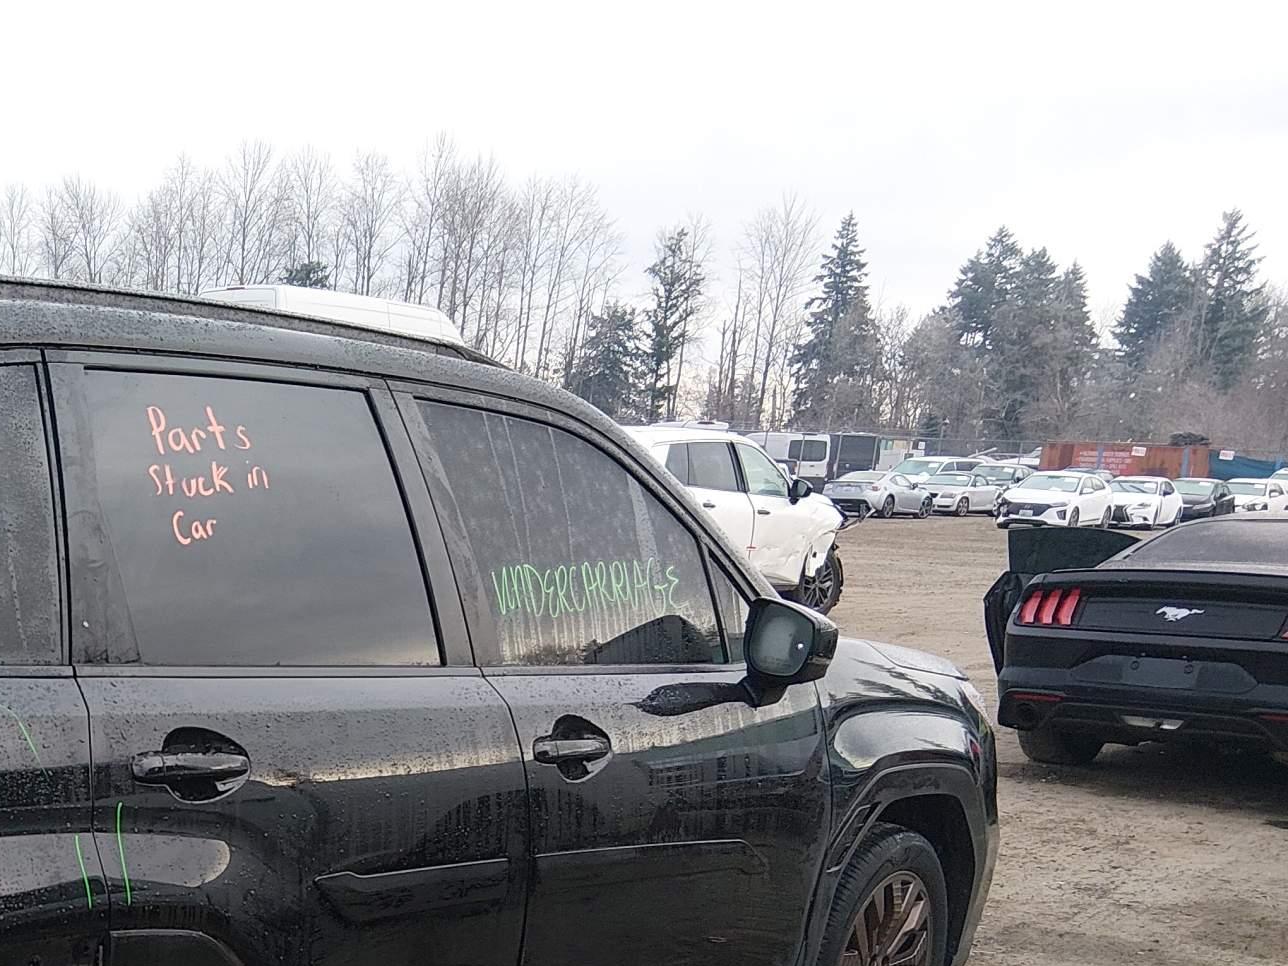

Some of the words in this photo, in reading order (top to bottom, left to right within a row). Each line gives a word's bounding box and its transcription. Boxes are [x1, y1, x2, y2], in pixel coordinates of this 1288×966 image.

[146, 405, 251, 455] Parts
[148, 461, 234, 497] Stuck
[246, 460, 269, 489] in
[172, 510, 217, 545] Car
[491, 557, 689, 618] UNDERCARRIAGE
